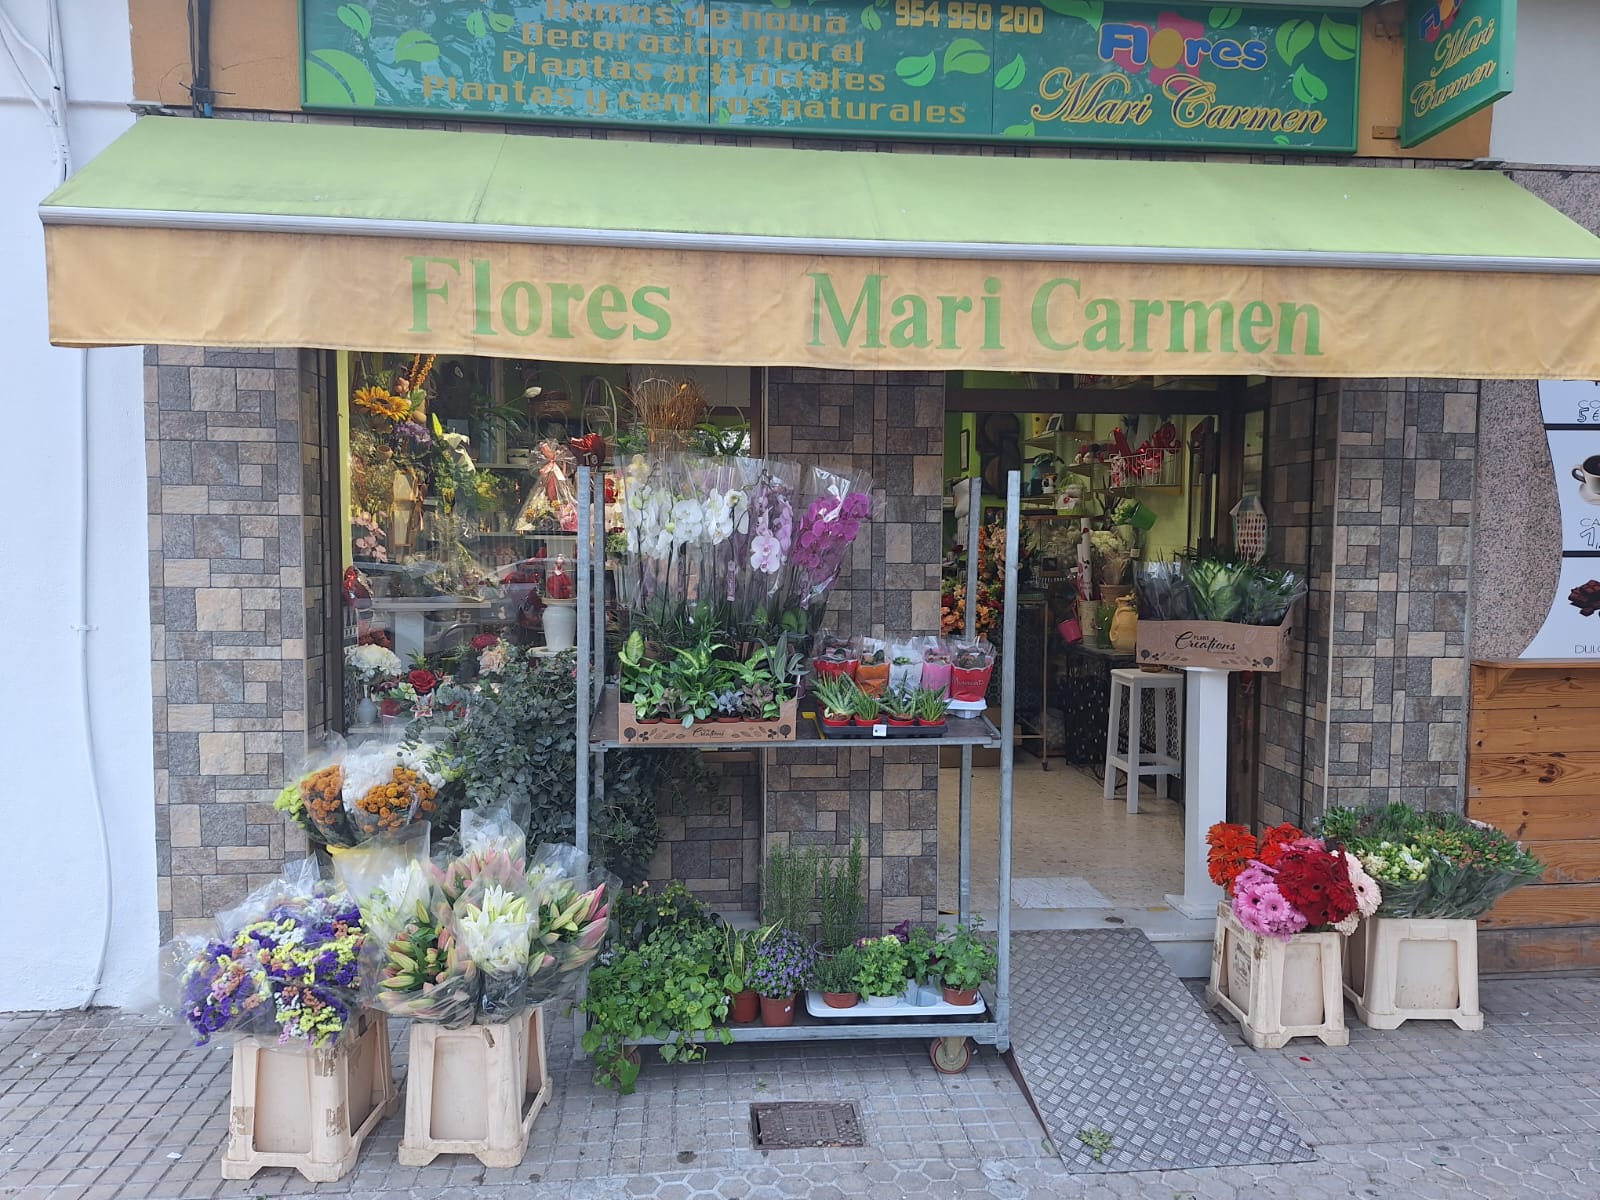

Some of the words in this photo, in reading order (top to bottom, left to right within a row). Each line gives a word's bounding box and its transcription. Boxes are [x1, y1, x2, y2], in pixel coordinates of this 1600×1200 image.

[546, 0, 673, 25] Ramos
[685, 4, 729, 28] de
[742, 9, 848, 34] novia
[895, 1, 940, 28] 954
[947, 3, 992, 31] 950
[999, 6, 1043, 34] 200
[757, 36, 864, 63] floral
[1430, 16, 1495, 77] Mari
[503, 50, 652, 81] Plantas
[663, 62, 886, 92] artificiales
[1410, 60, 1496, 117] Carmen
[423, 75, 574, 106] Plantas
[585, 89, 607, 114] y
[618, 90, 770, 118] centros
[781, 97, 967, 124] naturales
[1030, 67, 1153, 126] Mari
[1162, 73, 1328, 134] Carmen
[404, 255, 672, 342] Flores
[806, 271, 1006, 350] Mari
[1030, 277, 1325, 357] Carmen
[1175, 631, 1236, 652] Creations
